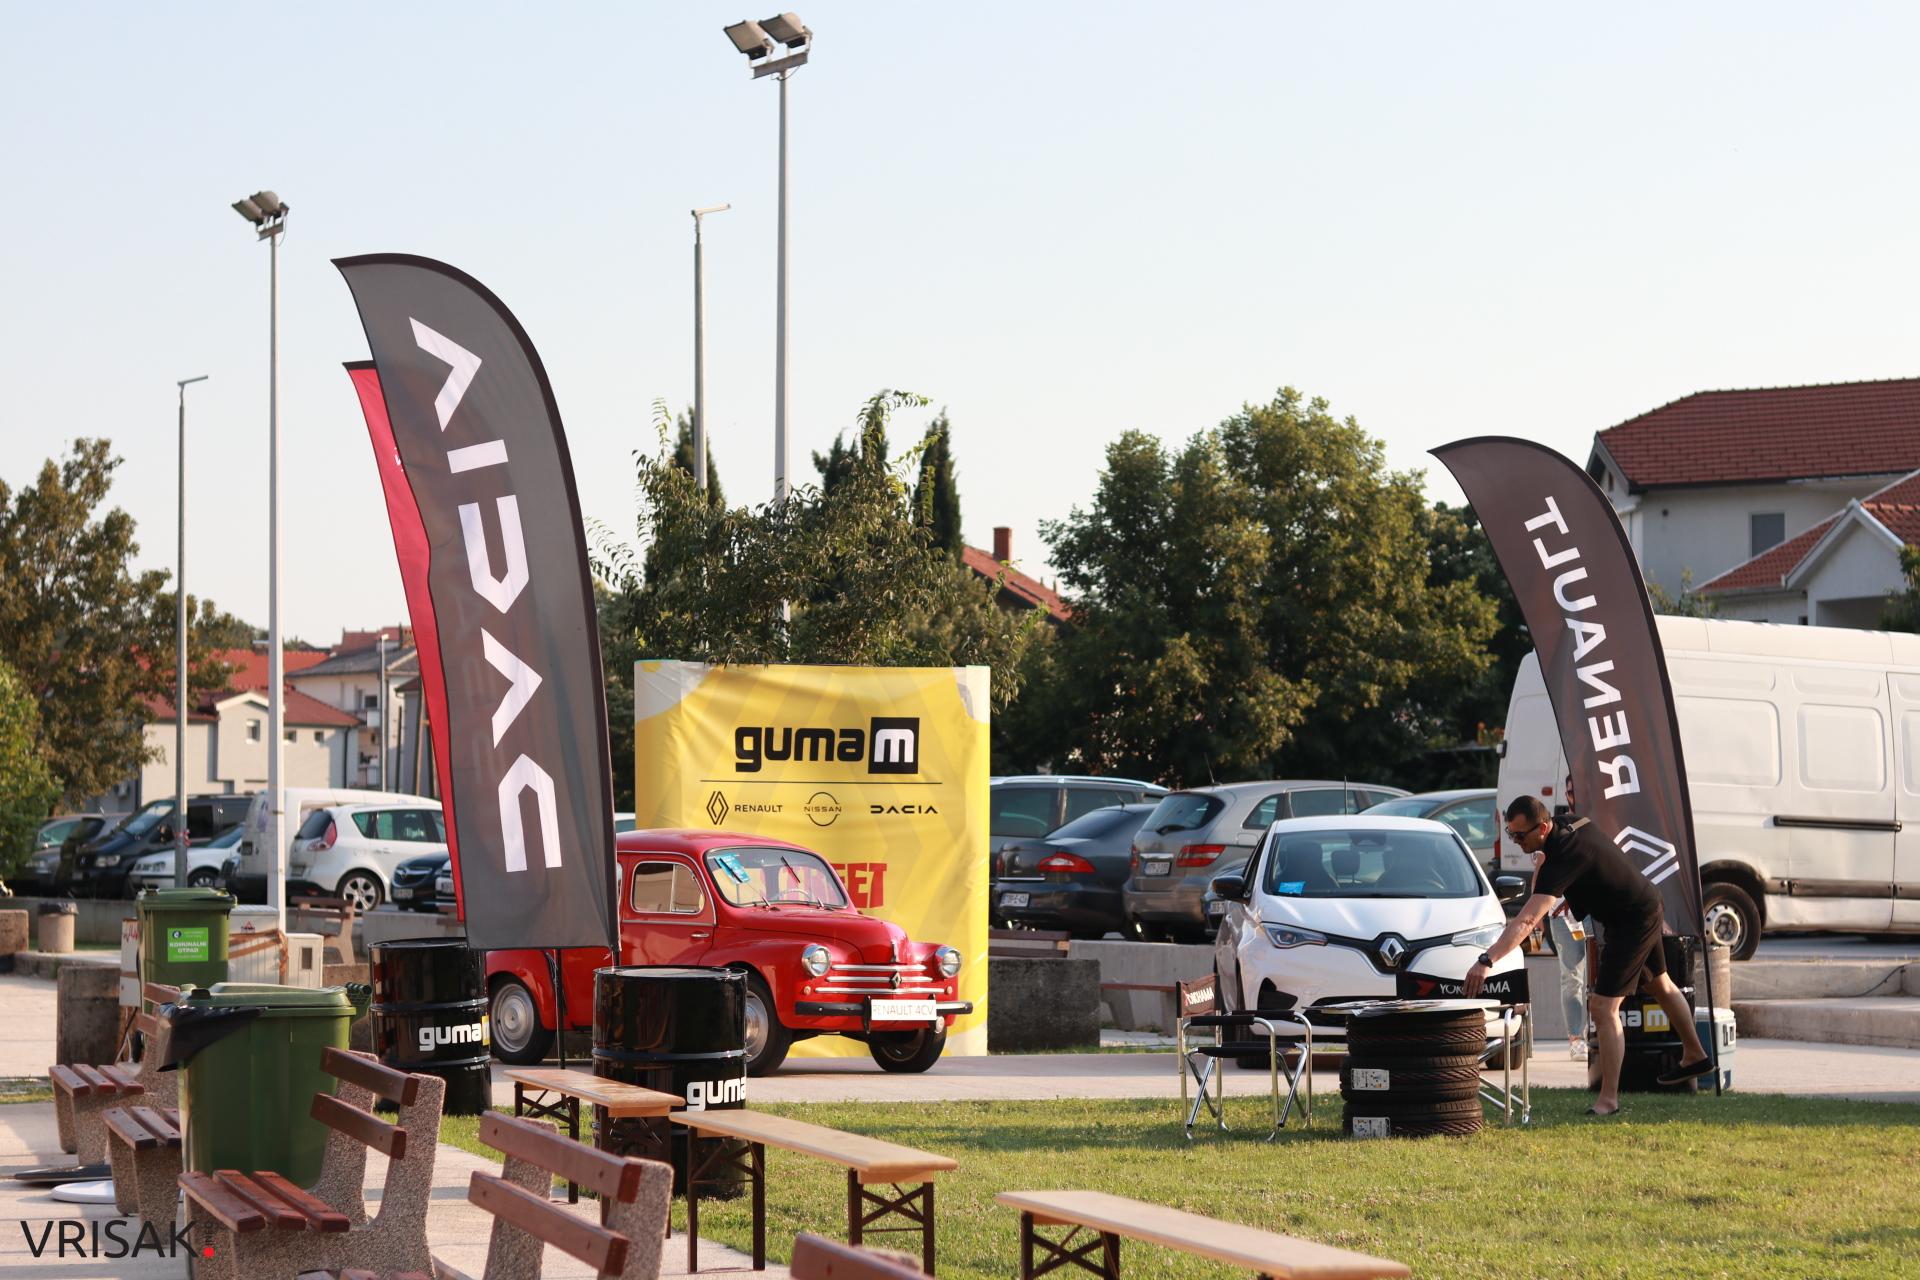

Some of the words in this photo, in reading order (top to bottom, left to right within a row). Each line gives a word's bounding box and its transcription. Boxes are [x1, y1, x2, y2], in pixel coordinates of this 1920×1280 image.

[734, 804, 783, 813] RENAULT
[870, 805, 938, 814] DACIA
[915, 1004, 934, 1015] 4CV
